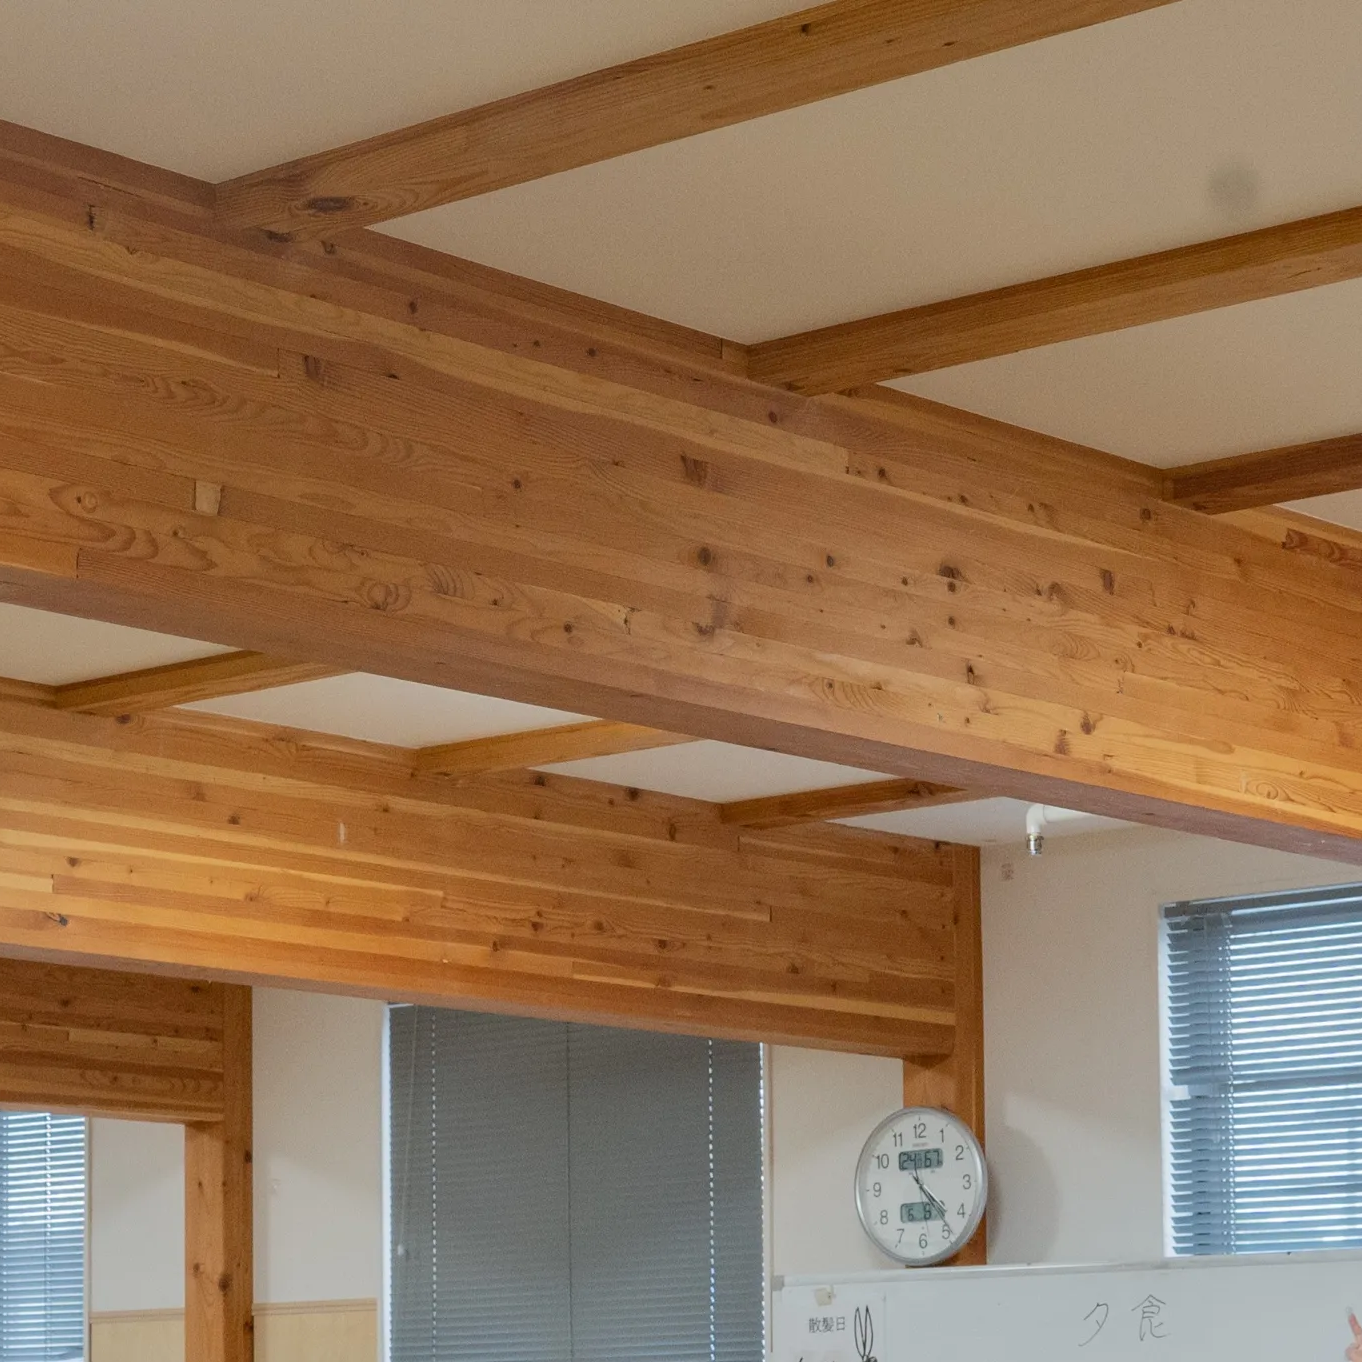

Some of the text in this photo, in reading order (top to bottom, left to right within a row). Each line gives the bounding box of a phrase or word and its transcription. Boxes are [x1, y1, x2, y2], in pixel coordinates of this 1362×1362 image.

[913, 1123, 927, 1138] 12
[939, 1128, 945, 1143] 1
[893, 1132, 903, 1147] 11
[876, 1153, 889, 1169] 10
[955, 1145, 964, 1161] 2
[873, 1182, 882, 1197] 9
[962, 1174, 972, 1190] 3
[880, 1210, 889, 1225] 8
[957, 1203, 965, 1218] 4
[896, 1228, 905, 1244] 7
[942, 1224, 951, 1240] 5
[919, 1233, 928, 1249] 6
[808, 1316, 846, 1333] 散髪日
[1078, 1294, 1170, 1346] 夕食
